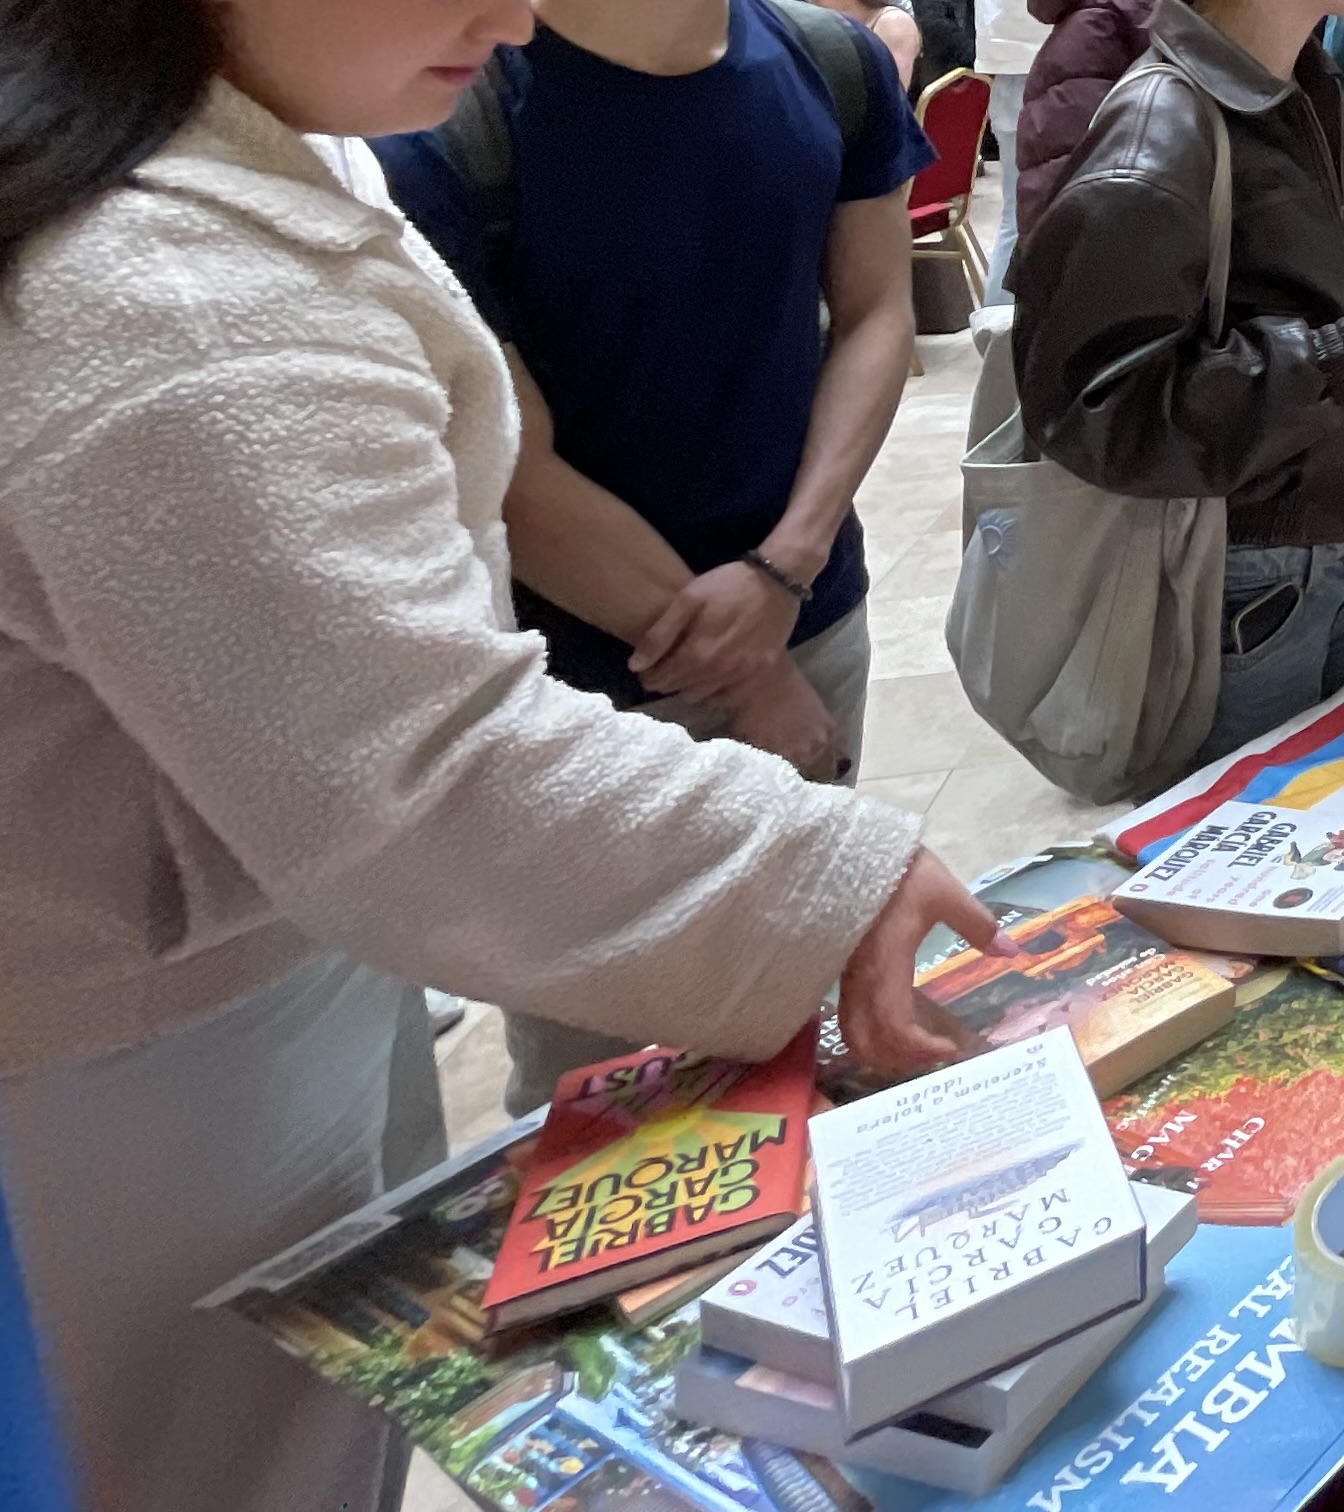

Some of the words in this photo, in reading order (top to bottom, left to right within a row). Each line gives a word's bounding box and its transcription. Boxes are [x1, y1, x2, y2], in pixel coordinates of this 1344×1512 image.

[1144, 824, 1231, 881] MÁRQUEZ
[1210, 810, 1278, 852] GARCÍA
[1226, 822, 1297, 868] GABRIEL
[856, 1103, 924, 1134] kolera
[529, 1184, 760, 1274] GABRIEL
[863, 1215, 1062, 1310] GARCÍA
[895, 1216, 1112, 1320] GABRIEL
[1027, 1324, 1241, 1512] REALISM
